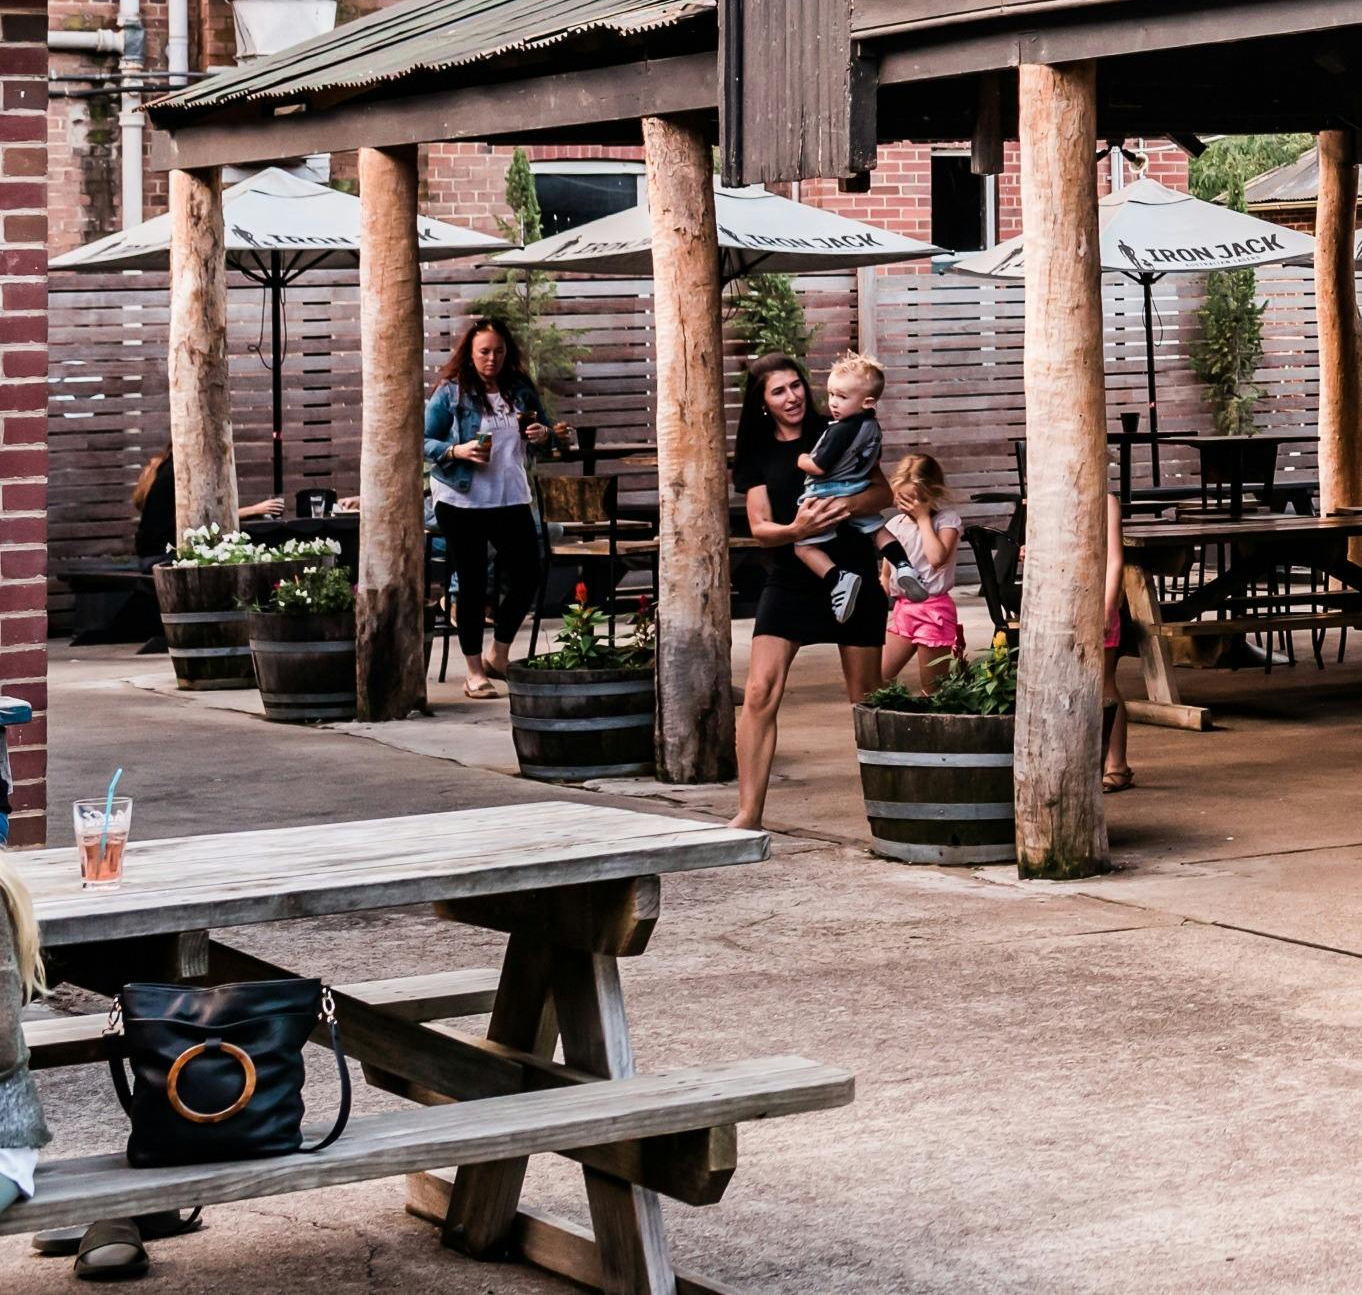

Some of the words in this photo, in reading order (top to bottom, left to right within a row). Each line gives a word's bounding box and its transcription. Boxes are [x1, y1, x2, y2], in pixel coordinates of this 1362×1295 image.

[745, 233, 815, 248] IRON
[812, 233, 884, 249] JACK
[1145, 246, 1216, 262] IRON
[1215, 234, 1285, 258] JACK
